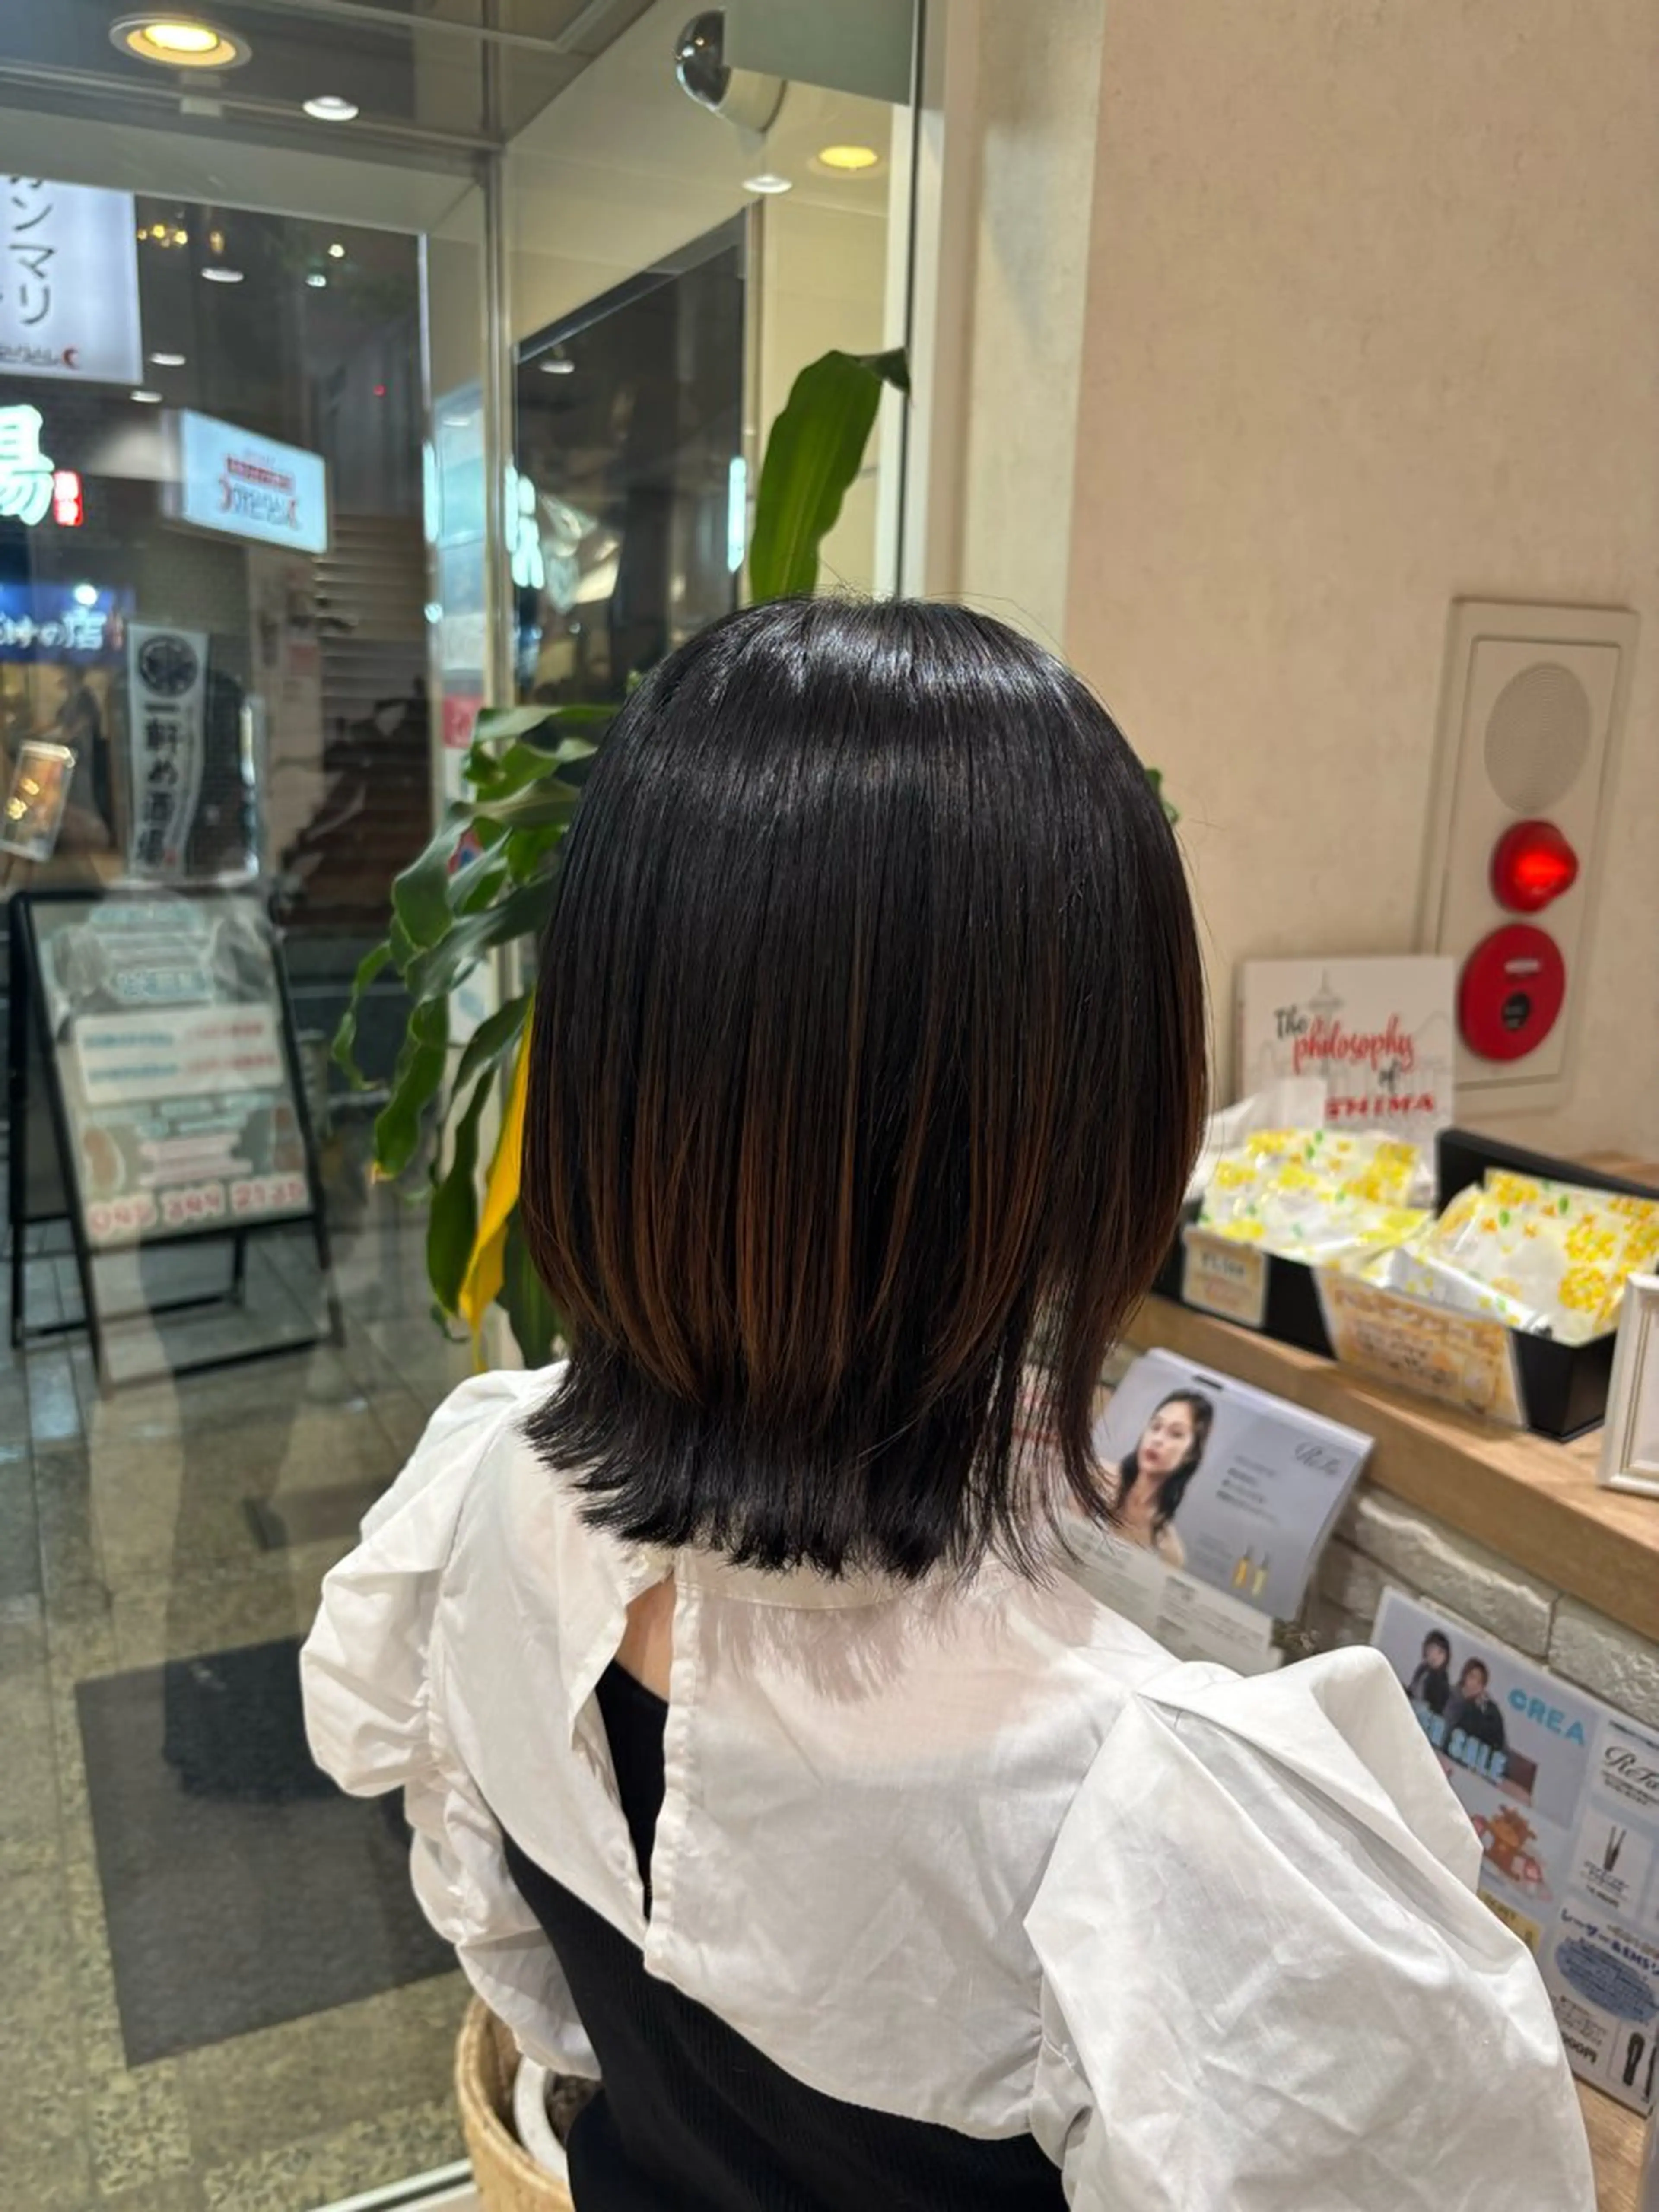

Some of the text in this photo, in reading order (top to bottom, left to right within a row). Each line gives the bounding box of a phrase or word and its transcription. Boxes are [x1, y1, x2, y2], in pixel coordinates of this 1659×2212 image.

[9, 176, 55, 326] ンマリ
[1293, 1012, 1414, 1075] philosophy
